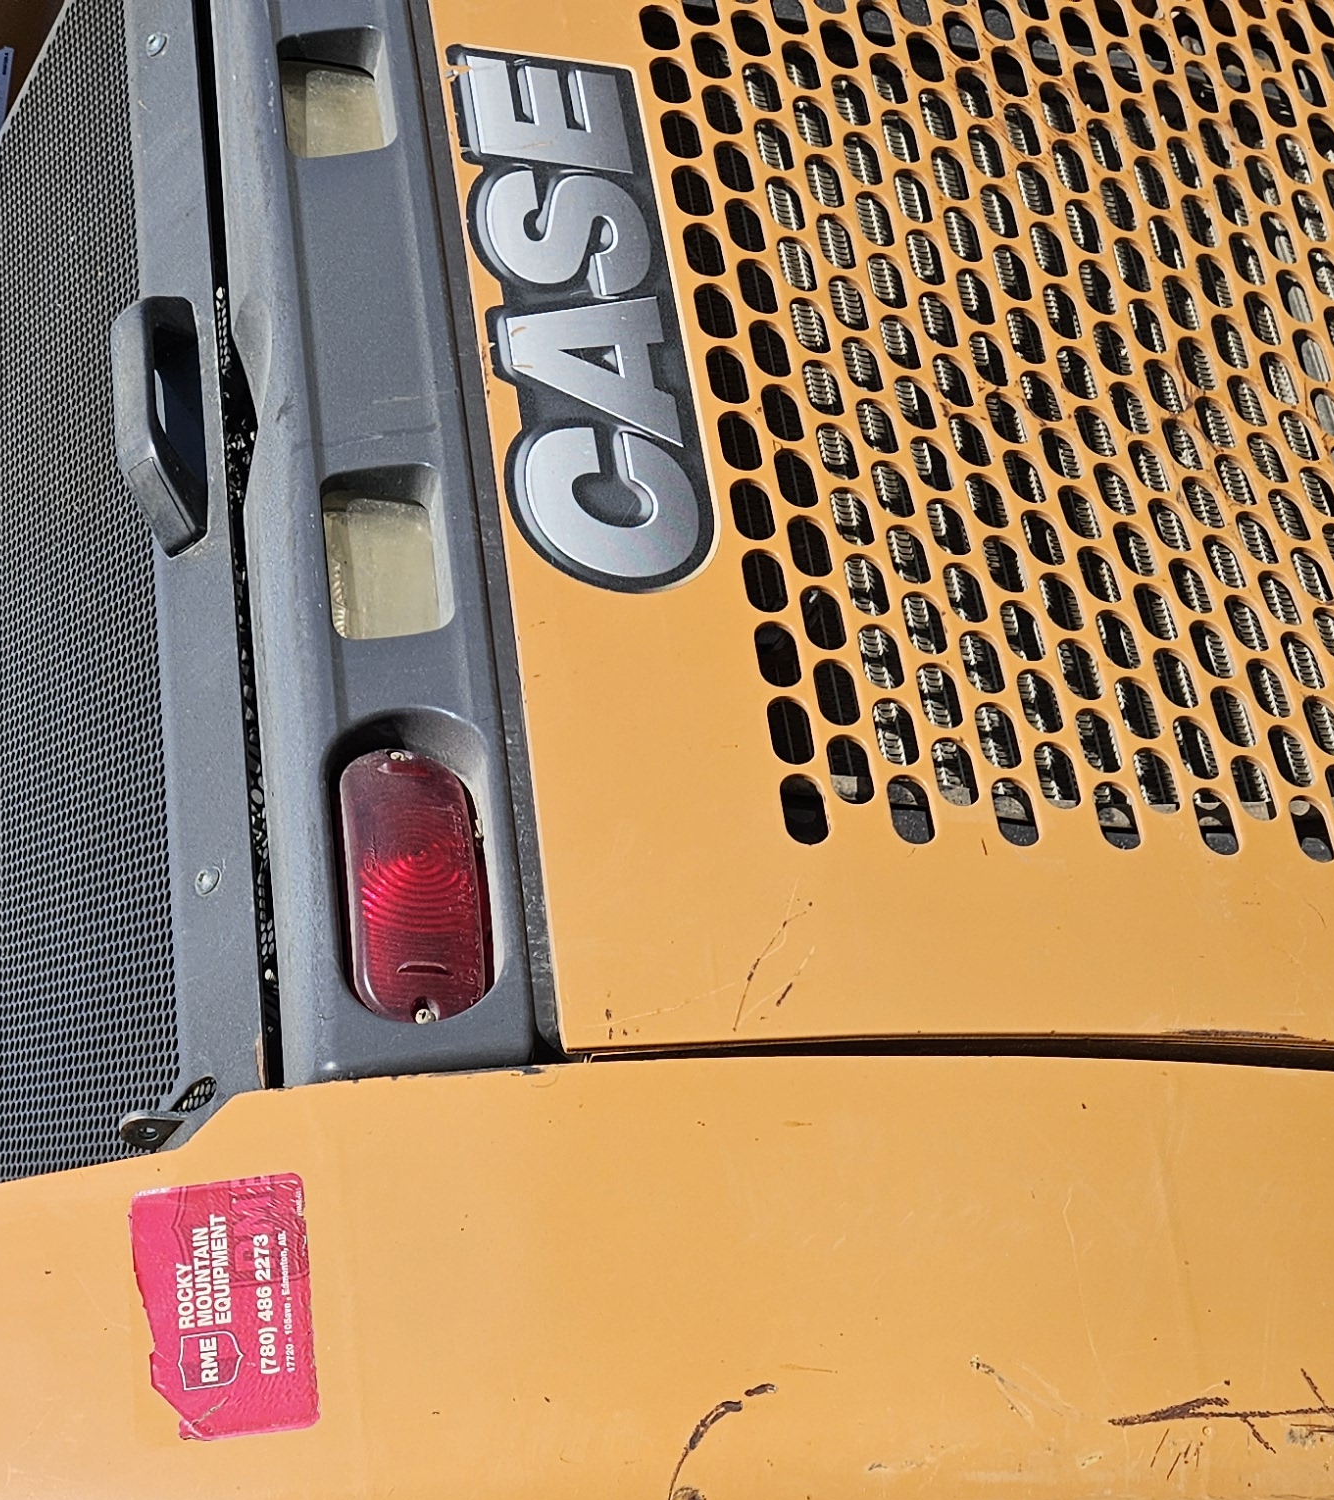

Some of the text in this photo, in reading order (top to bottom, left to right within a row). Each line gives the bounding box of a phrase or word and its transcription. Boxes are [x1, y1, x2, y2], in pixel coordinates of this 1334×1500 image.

[460, 54, 701, 578] CASE
[176, 1263, 195, 1330] ROCKY
[192, 1226, 214, 1328] MOUNTAIN
[209, 1214, 232, 1325] EQUIPMENT
[253, 1233, 281, 1375] (780) 486 2273
[279, 1247, 291, 1296] Edmonton,
[199, 1336, 219, 1384] RME
[285, 1343, 296, 1373] 17720
